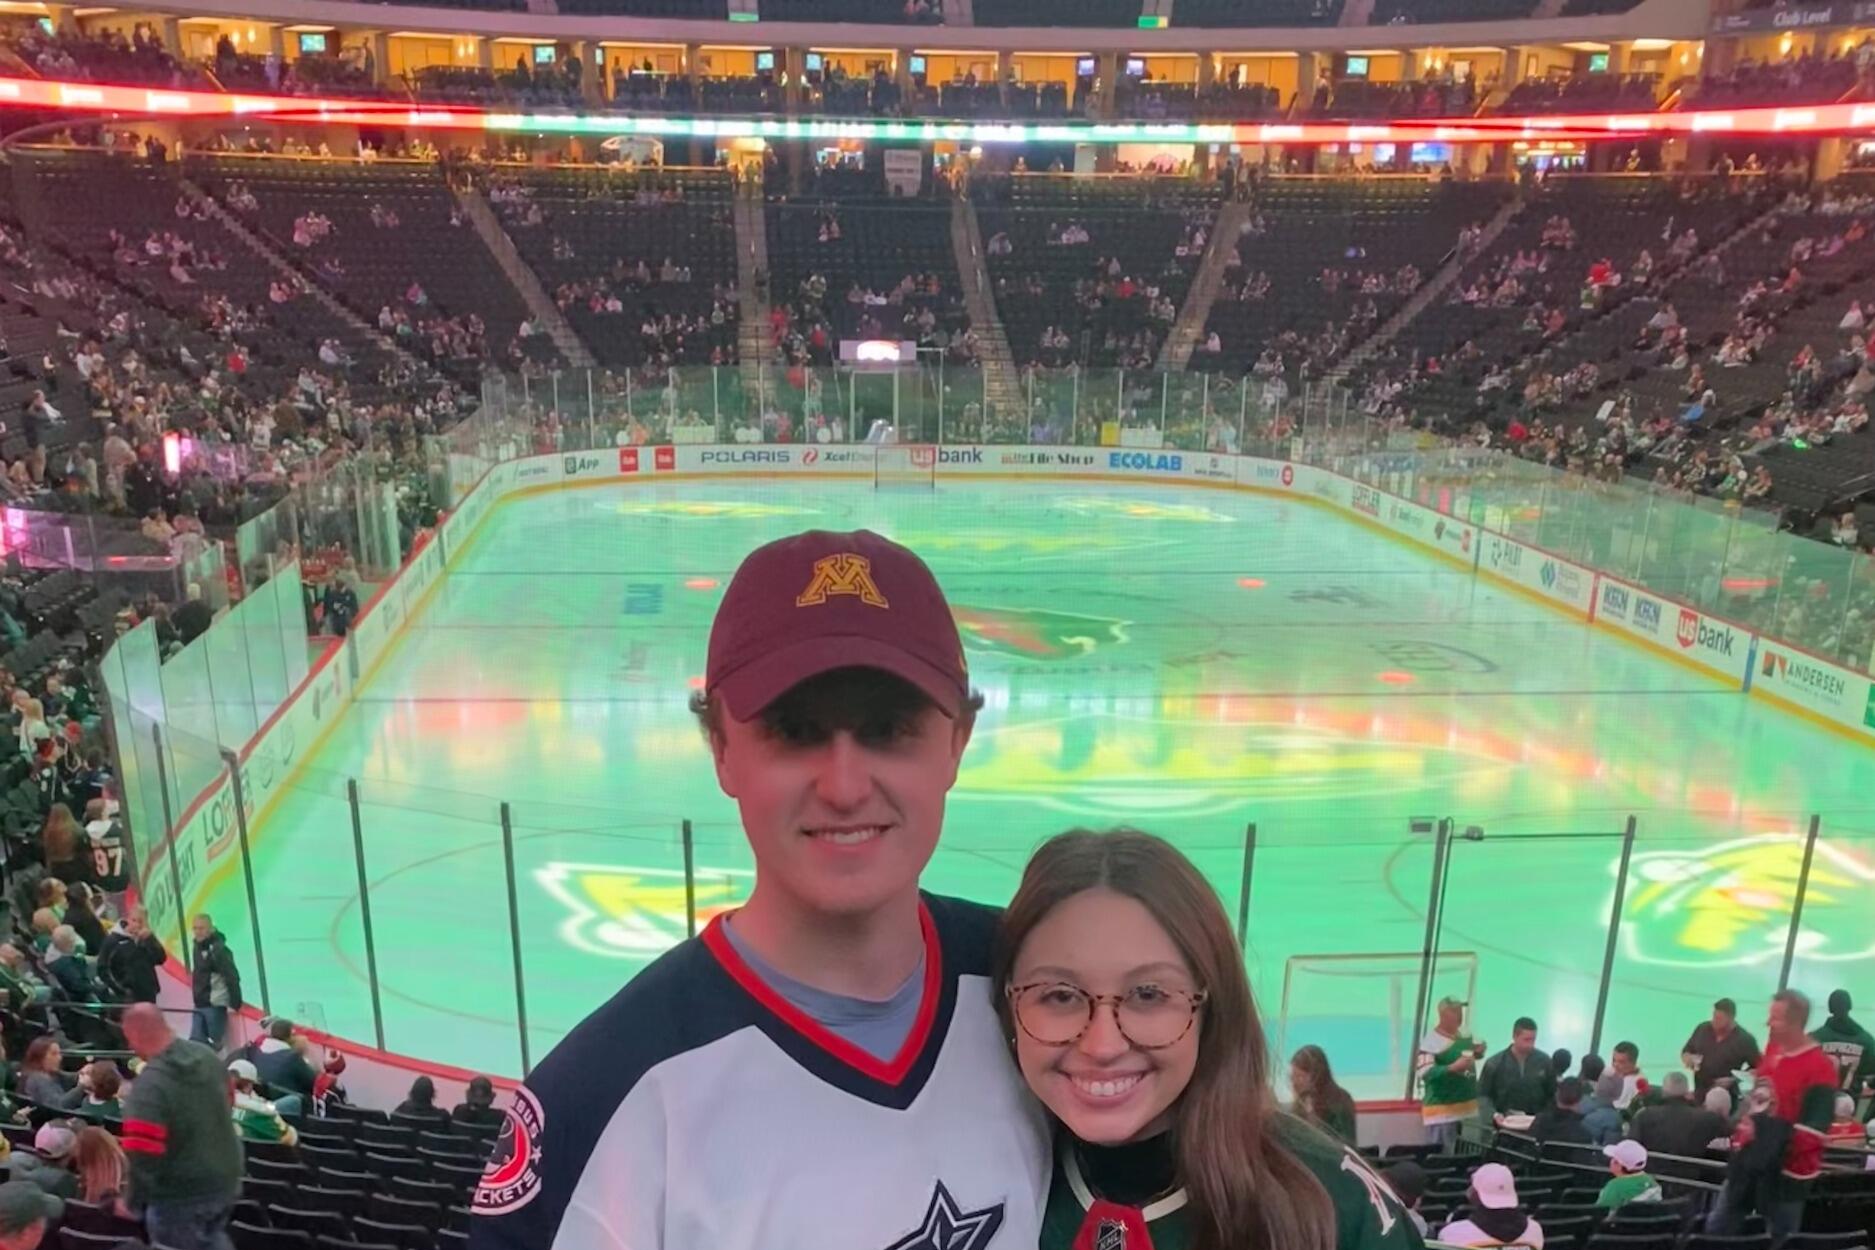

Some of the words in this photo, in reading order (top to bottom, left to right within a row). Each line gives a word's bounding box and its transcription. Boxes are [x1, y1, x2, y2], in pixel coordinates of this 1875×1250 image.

[1773, 12, 1800, 26] Club
[1803, 8, 1832, 23] Level
[701, 450, 790, 463] POLARIS
[938, 447, 983, 464] bank
[1109, 452, 1182, 471] ECOLAB
[1698, 616, 1734, 657] bank
[1788, 661, 1845, 695] ANDERSEN
